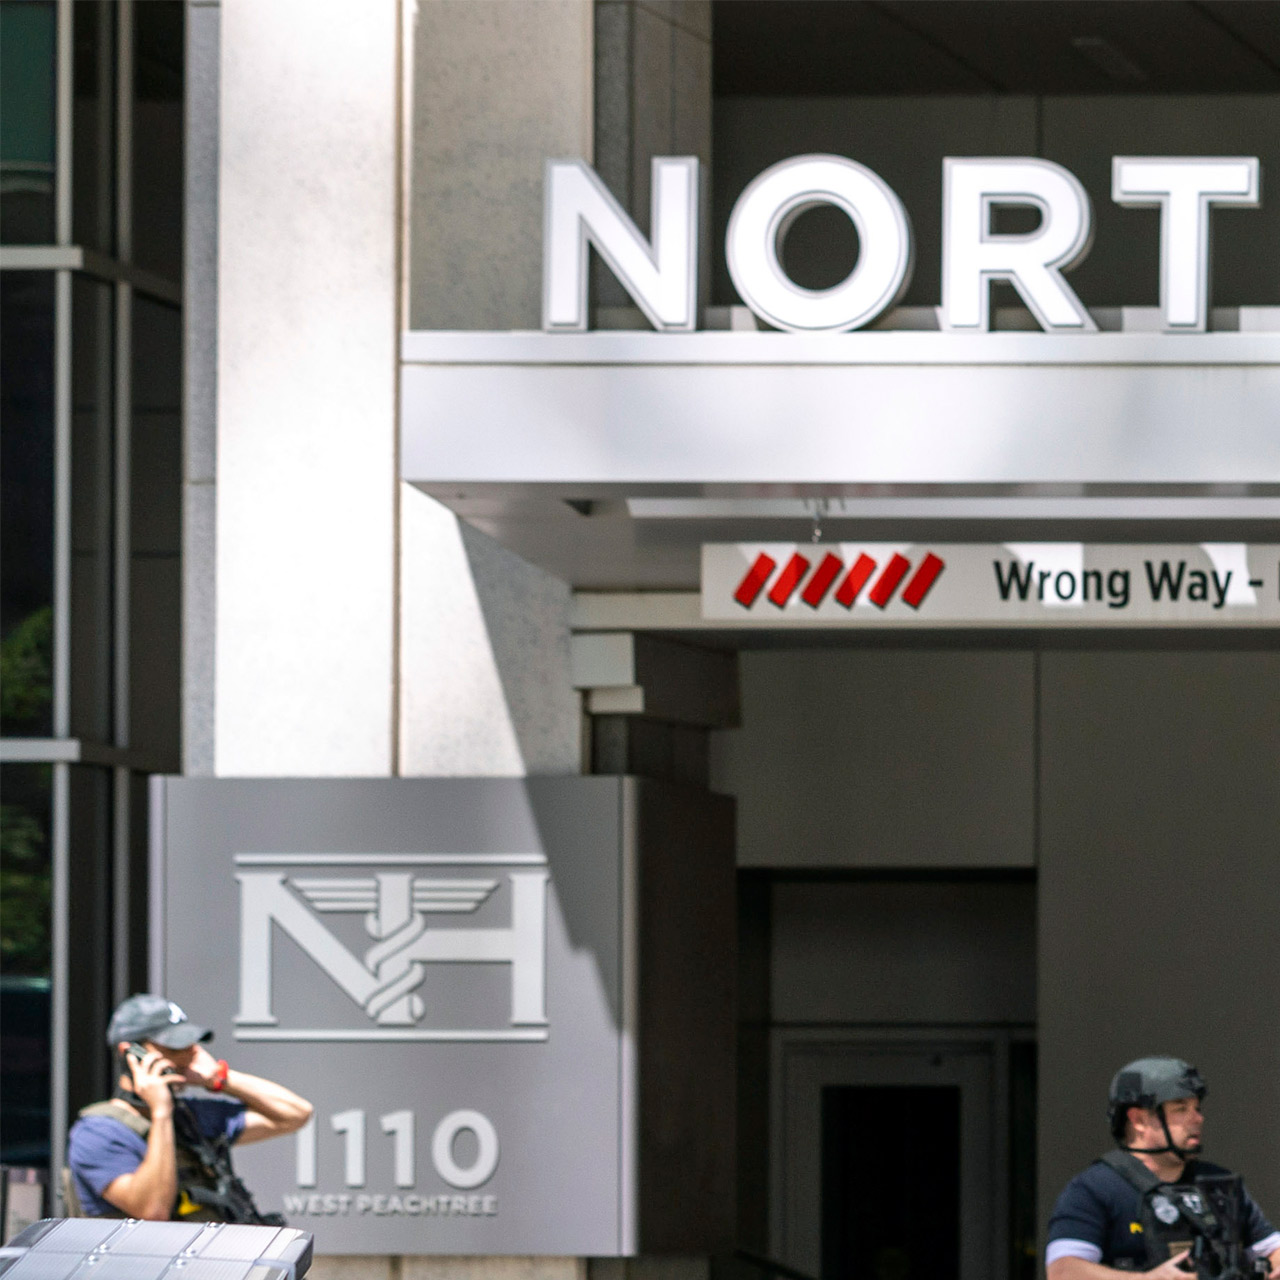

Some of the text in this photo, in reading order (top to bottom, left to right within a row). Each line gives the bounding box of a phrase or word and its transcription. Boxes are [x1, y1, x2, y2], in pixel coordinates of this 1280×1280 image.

[993, 560, 1131, 608] Wrong
[1145, 560, 1232, 608] Way
[294, 1108, 500, 1189] 1110
[283, 1194, 498, 1217] WEST PEACHTREE
